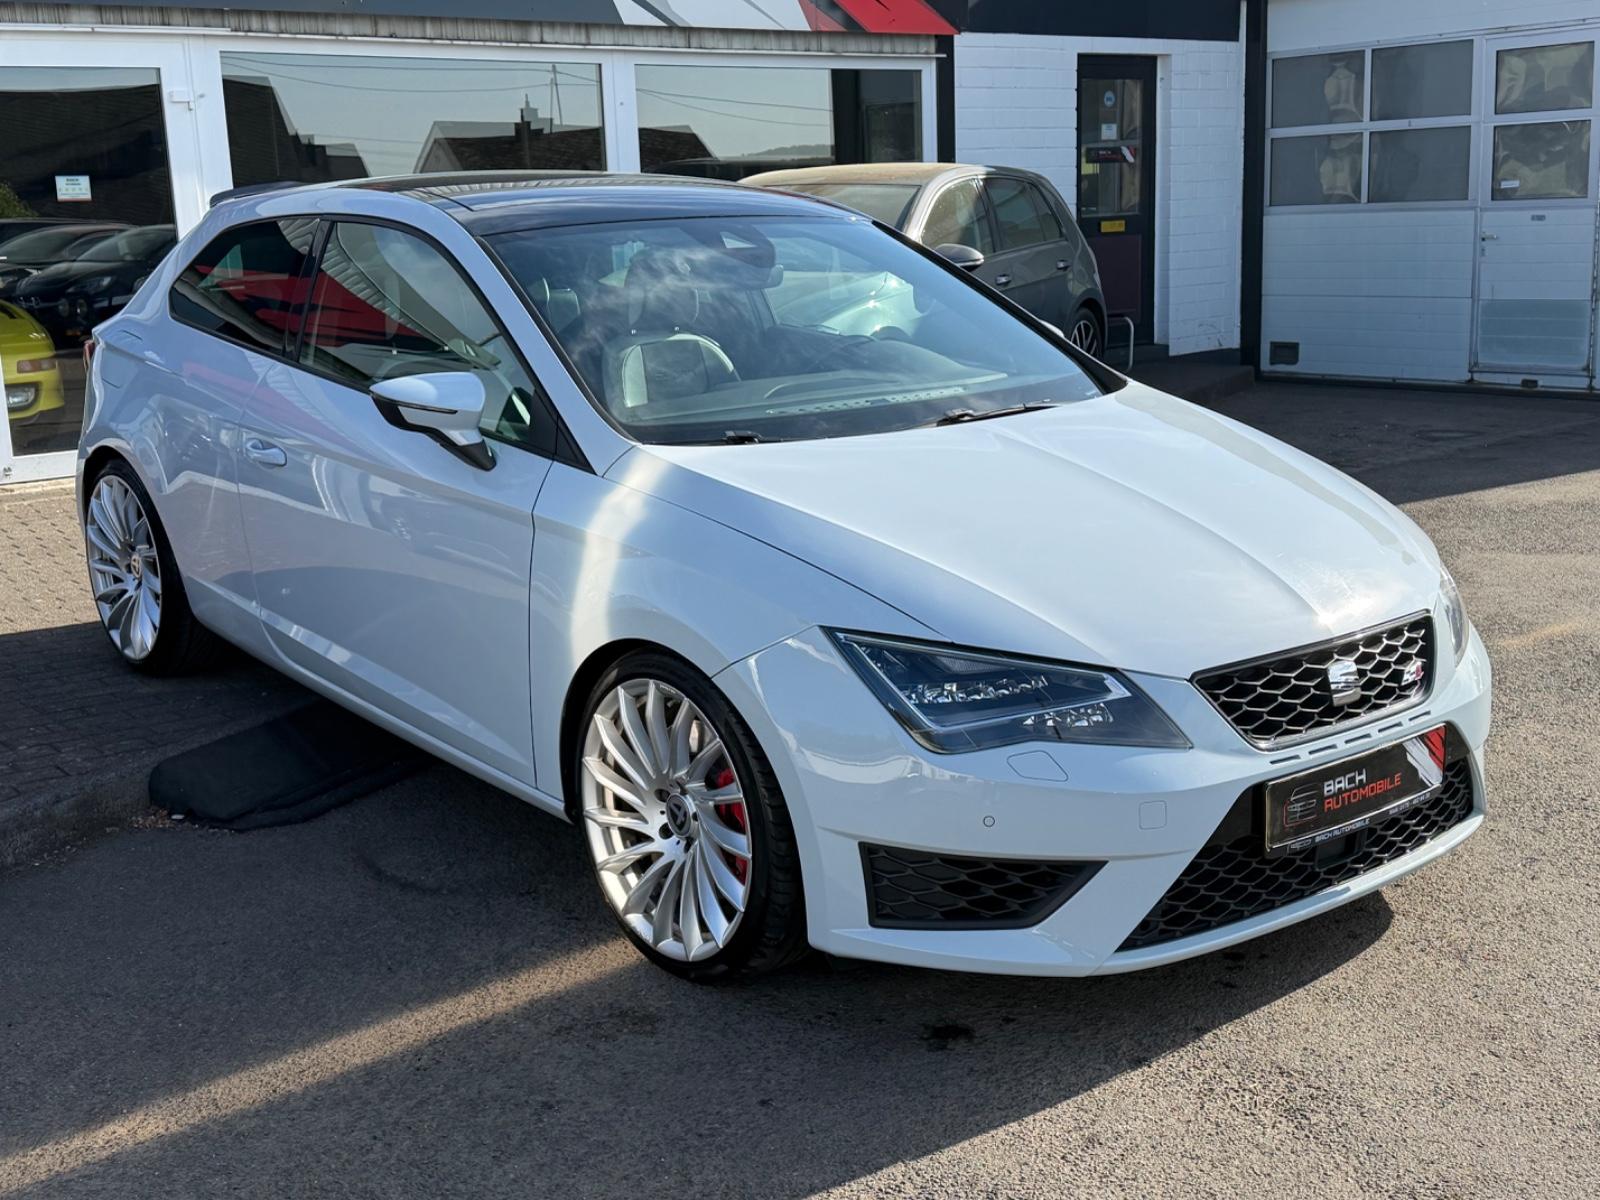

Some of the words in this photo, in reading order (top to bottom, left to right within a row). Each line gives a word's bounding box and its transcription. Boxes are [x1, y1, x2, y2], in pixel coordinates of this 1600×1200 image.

[1324, 768, 1366, 797] BACH
[1324, 772, 1402, 812] AUTOMOBILE
[1315, 832, 1333, 843] BACH
[1332, 818, 1370, 837] AUTOMOBILE
